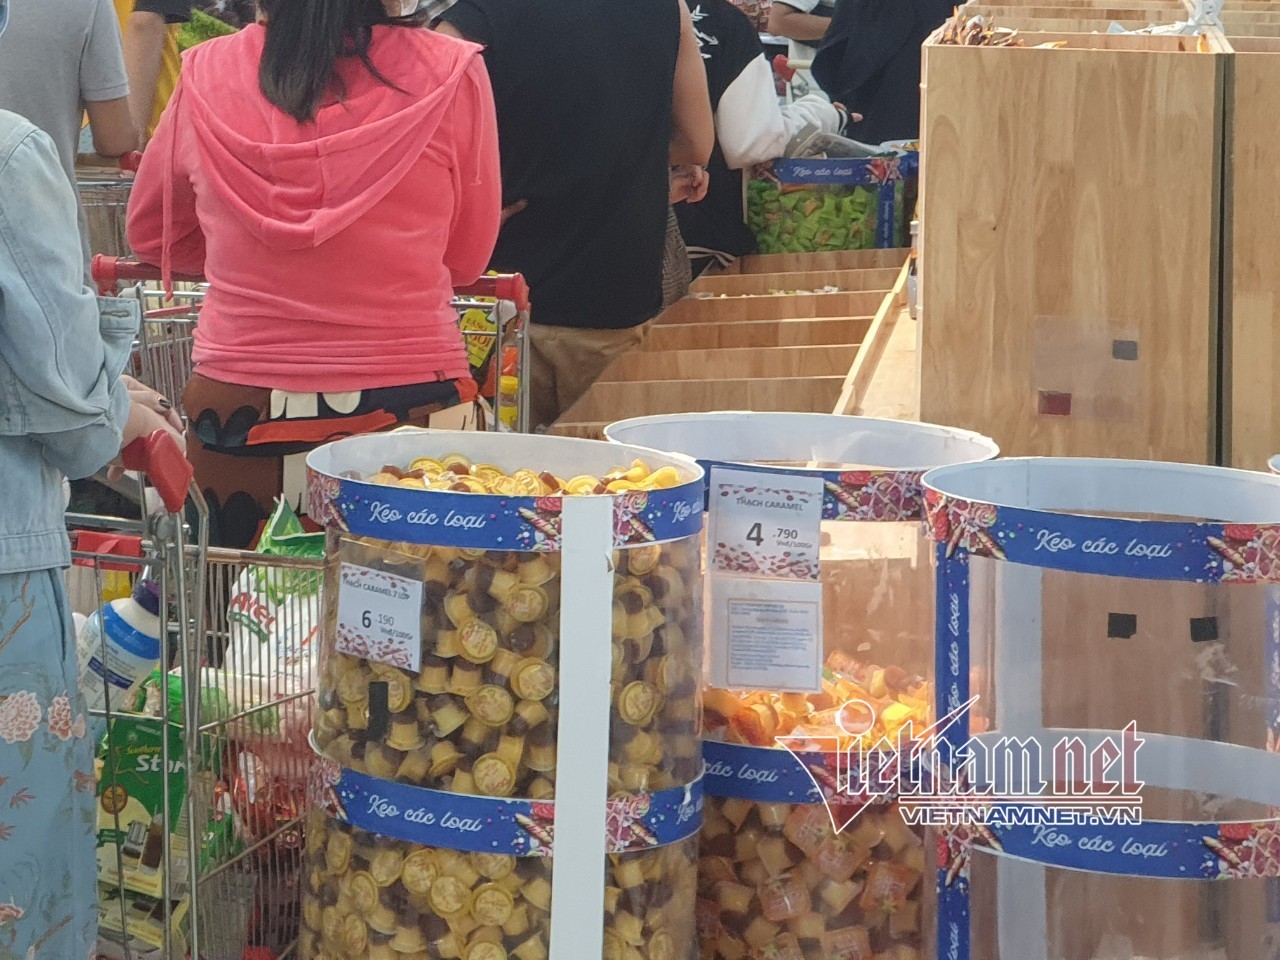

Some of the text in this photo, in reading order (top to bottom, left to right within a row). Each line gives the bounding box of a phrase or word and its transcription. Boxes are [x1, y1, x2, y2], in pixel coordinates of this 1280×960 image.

[765, 497, 804, 512] CARAMEL
[407, 508, 439, 525] các
[444, 510, 486, 530] loại
[746, 522, 764, 546] 4
[1082, 537, 1119, 554] các
[1125, 538, 1172, 559] loại
[362, 610, 372, 629] 6
[738, 763, 779, 783] loại
[404, 807, 436, 825] các
[440, 811, 482, 832] loại
[1078, 835, 1116, 852] các
[1121, 837, 1169, 858] loại
